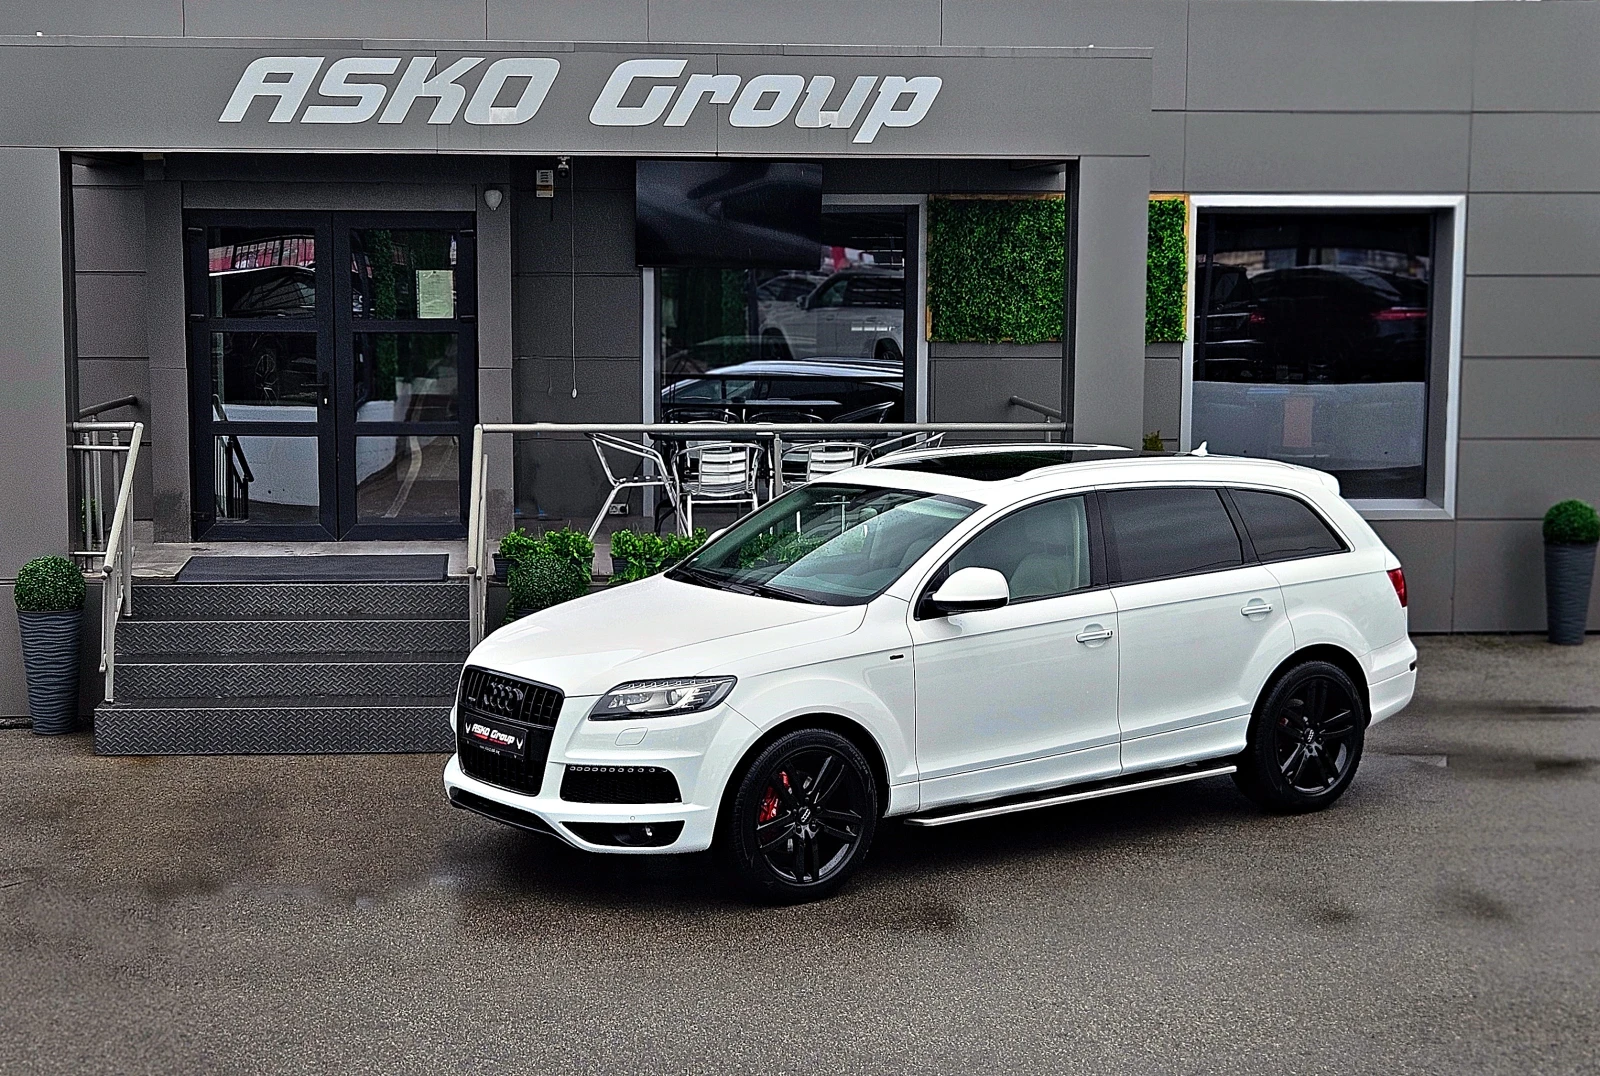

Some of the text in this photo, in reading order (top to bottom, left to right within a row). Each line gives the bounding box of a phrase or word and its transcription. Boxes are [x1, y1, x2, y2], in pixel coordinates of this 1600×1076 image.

[219, 56, 942, 144] ASKO Group
[471, 723, 491, 737] ASKO
[490, 729, 515, 745] Group
